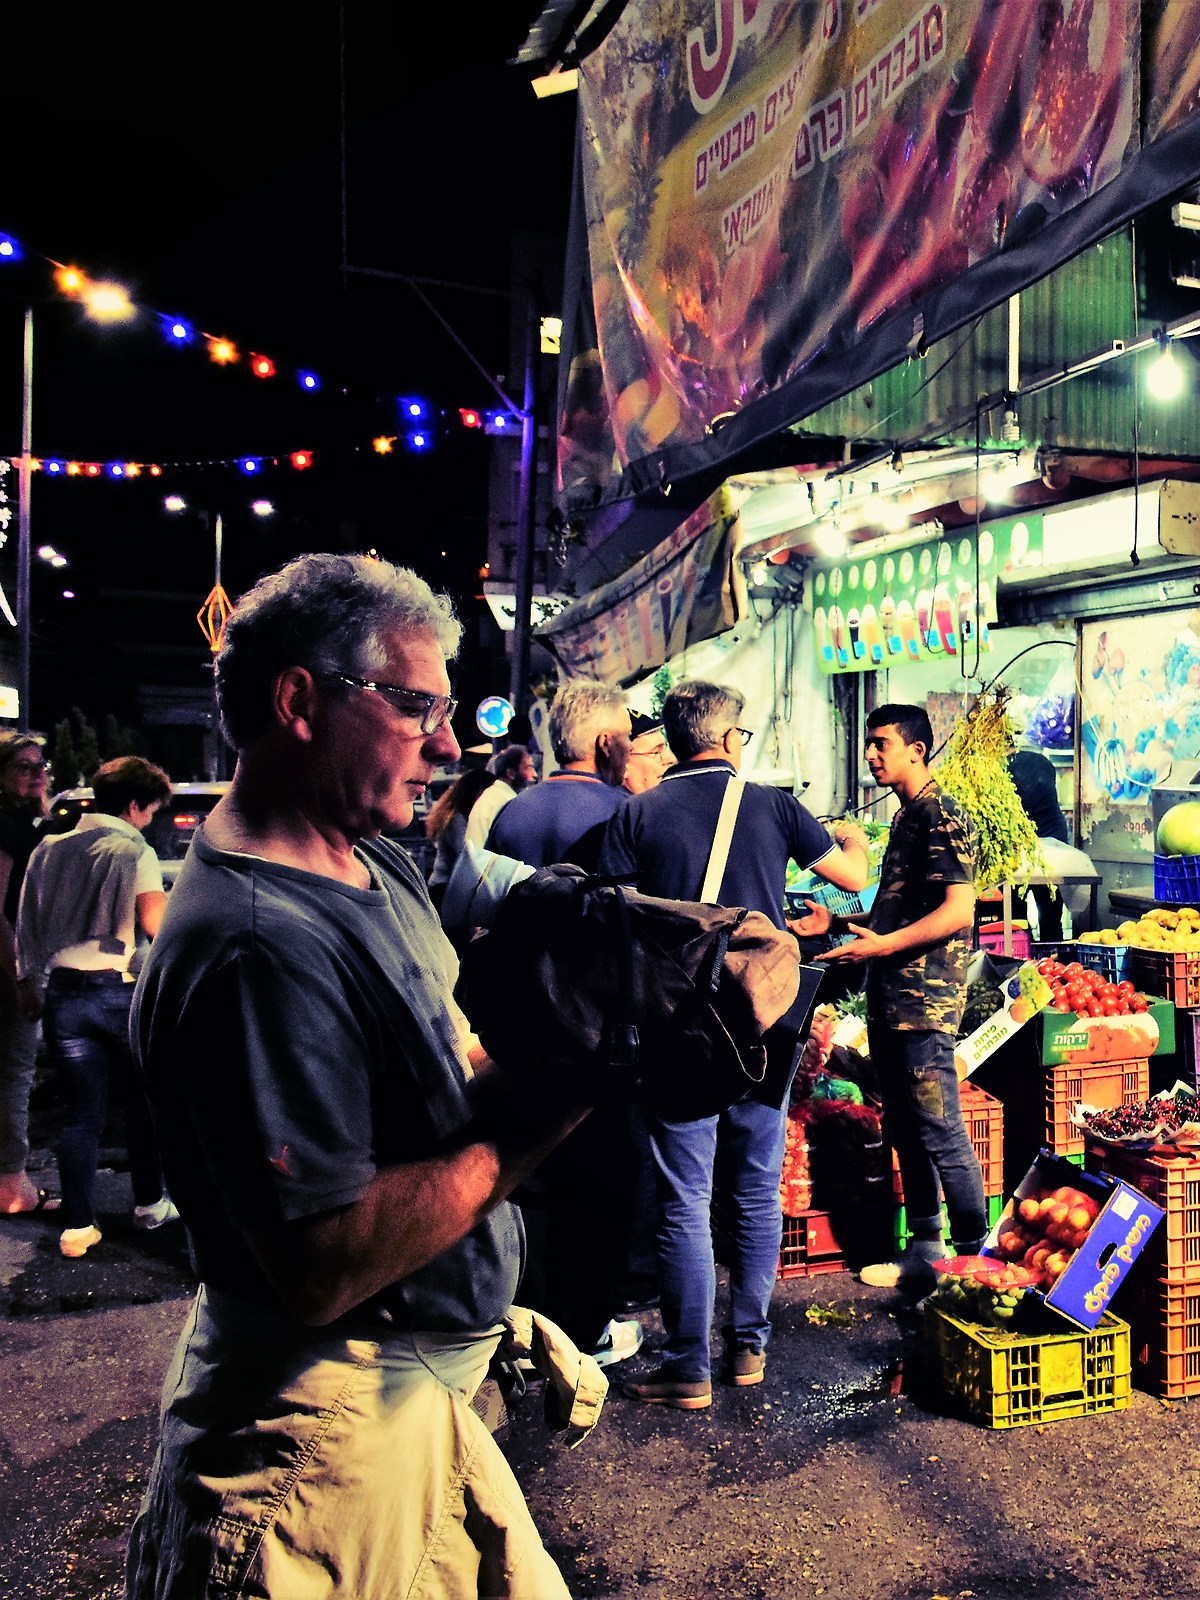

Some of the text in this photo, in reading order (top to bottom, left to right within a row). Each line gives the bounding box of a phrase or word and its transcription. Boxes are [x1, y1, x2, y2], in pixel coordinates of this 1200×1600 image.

[973, 1024, 997, 1048] פירות
[1054, 1034, 1086, 1046] ירקות
[1083, 1214, 1151, 1313] משק פוקס
